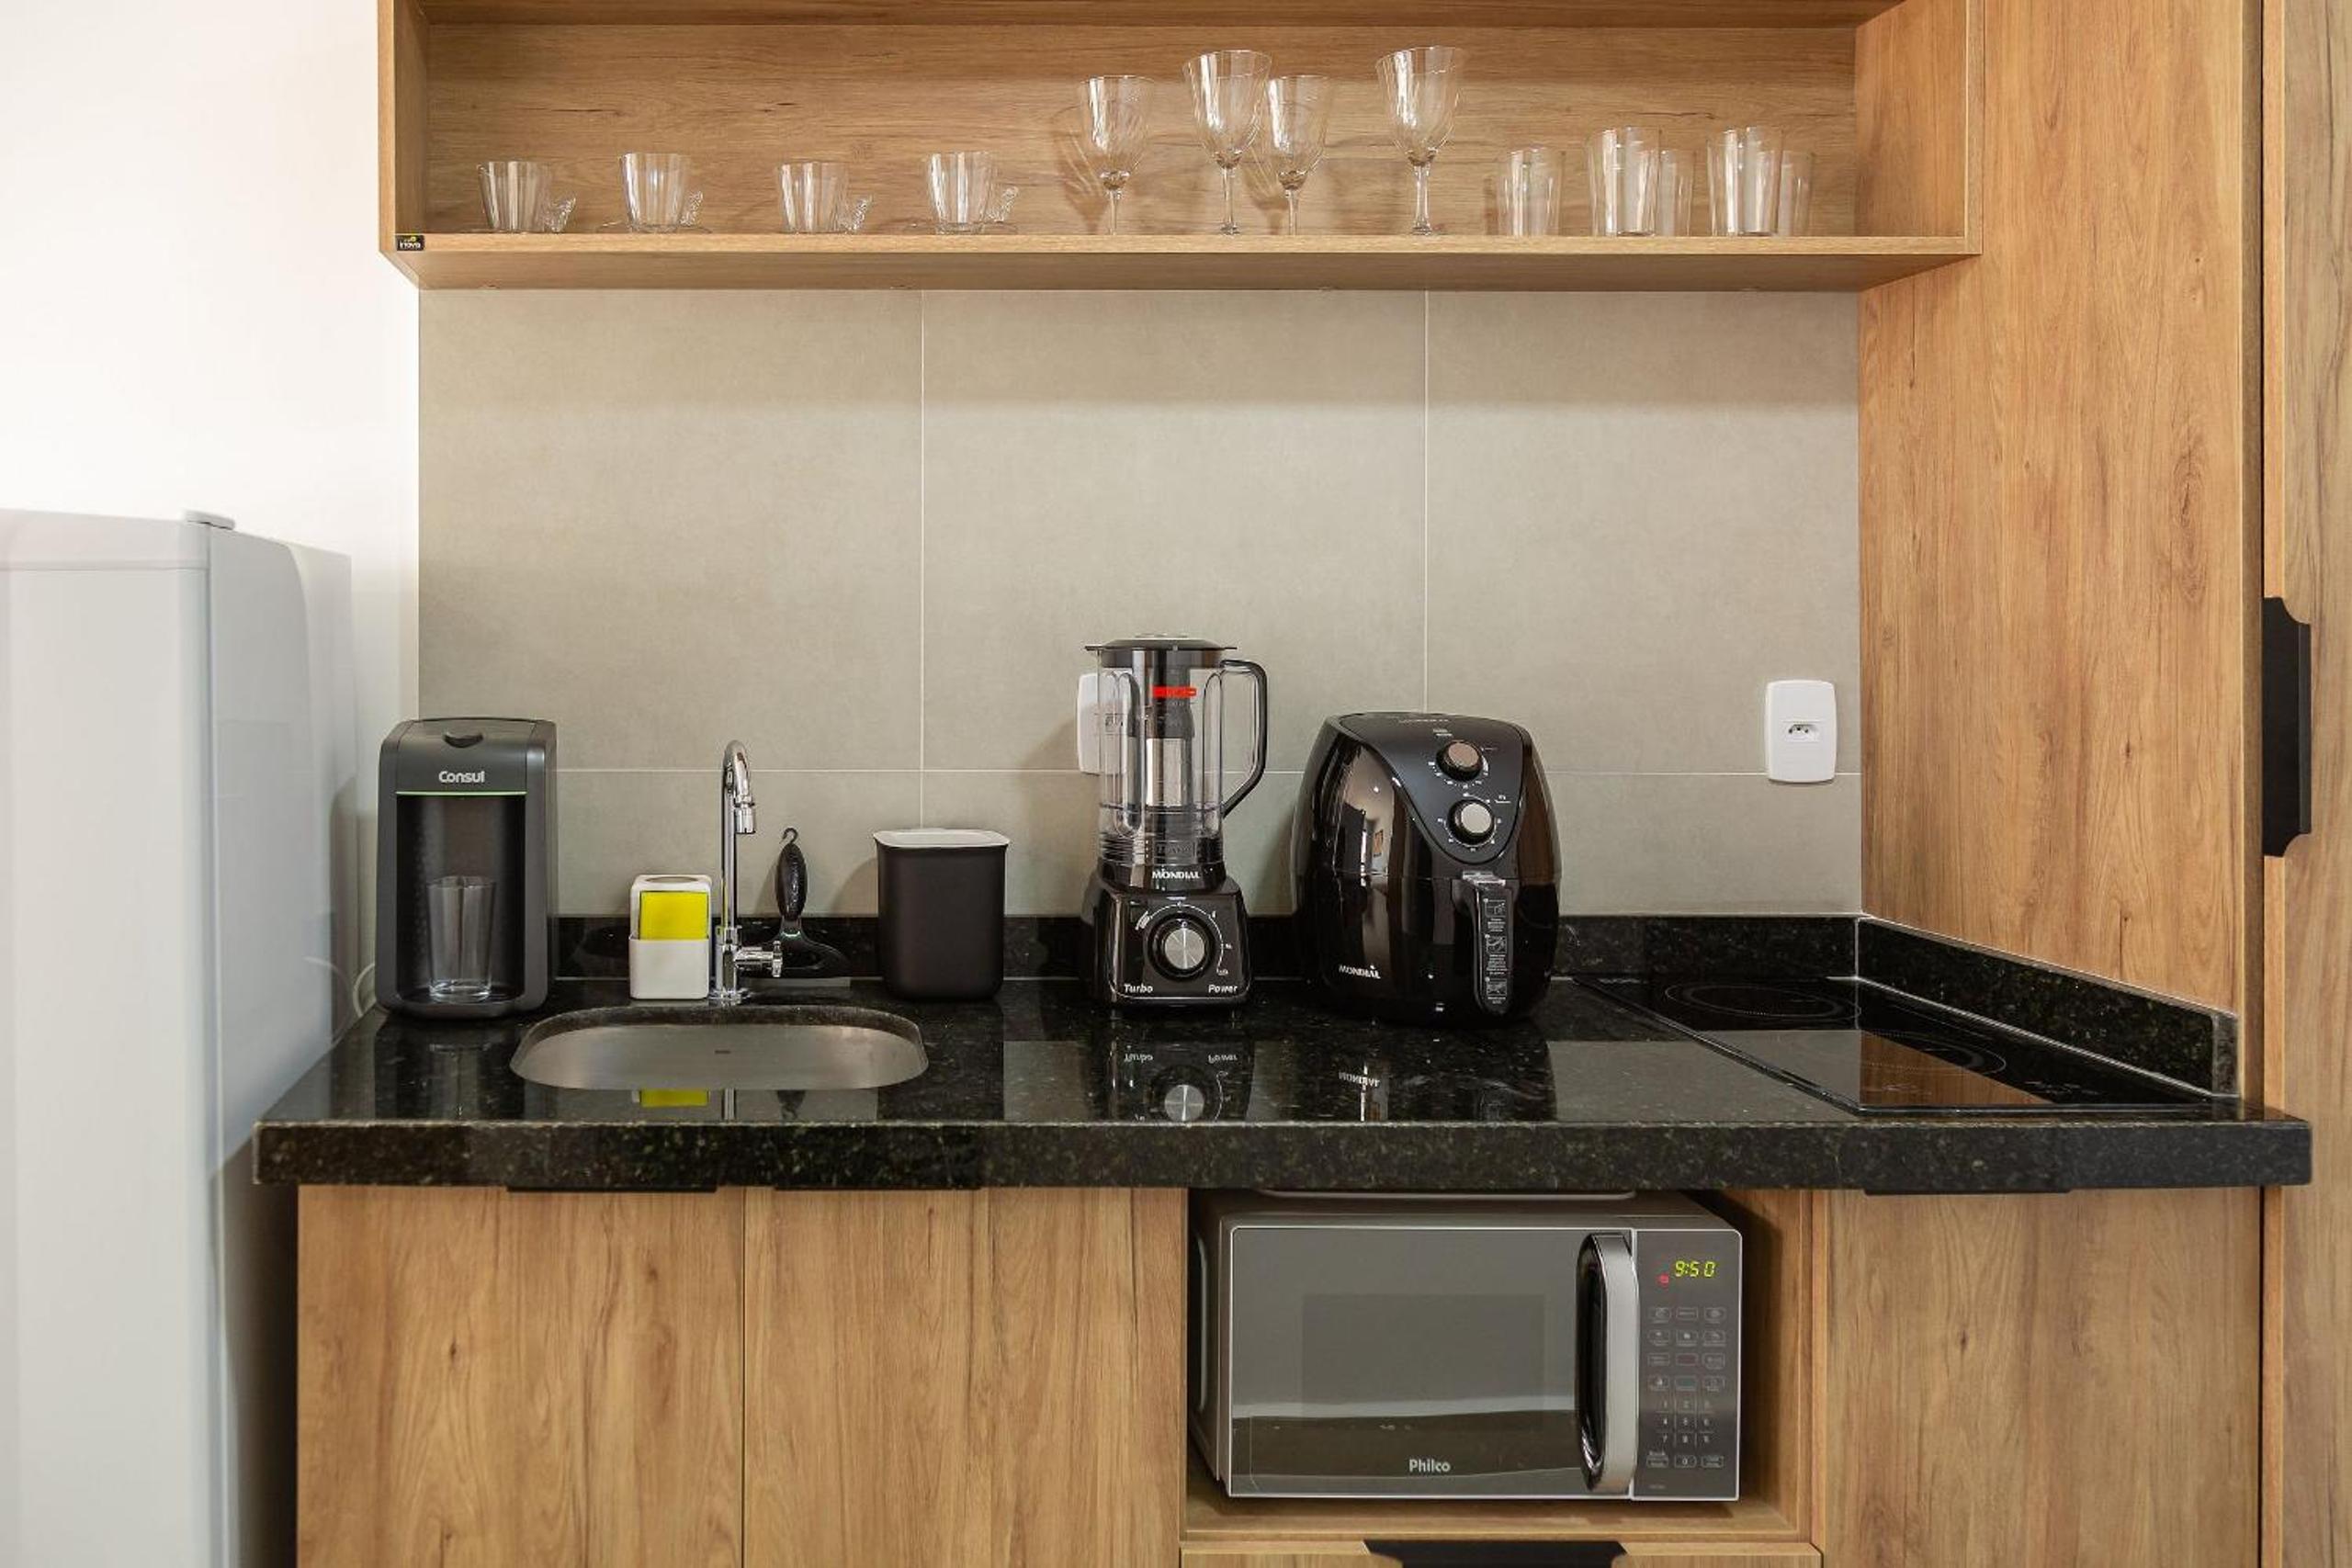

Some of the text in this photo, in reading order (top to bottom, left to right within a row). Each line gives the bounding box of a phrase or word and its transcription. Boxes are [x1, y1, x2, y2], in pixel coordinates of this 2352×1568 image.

[438, 771, 485, 783] Consul
[1152, 871, 1200, 879] MONDIAL
[1339, 964, 1381, 979] MONDIAL
[1124, 983, 1238, 993] Turbo Power
[1675, 1260, 1715, 1278] 9:50
[1408, 1458, 1452, 1472] Philco
